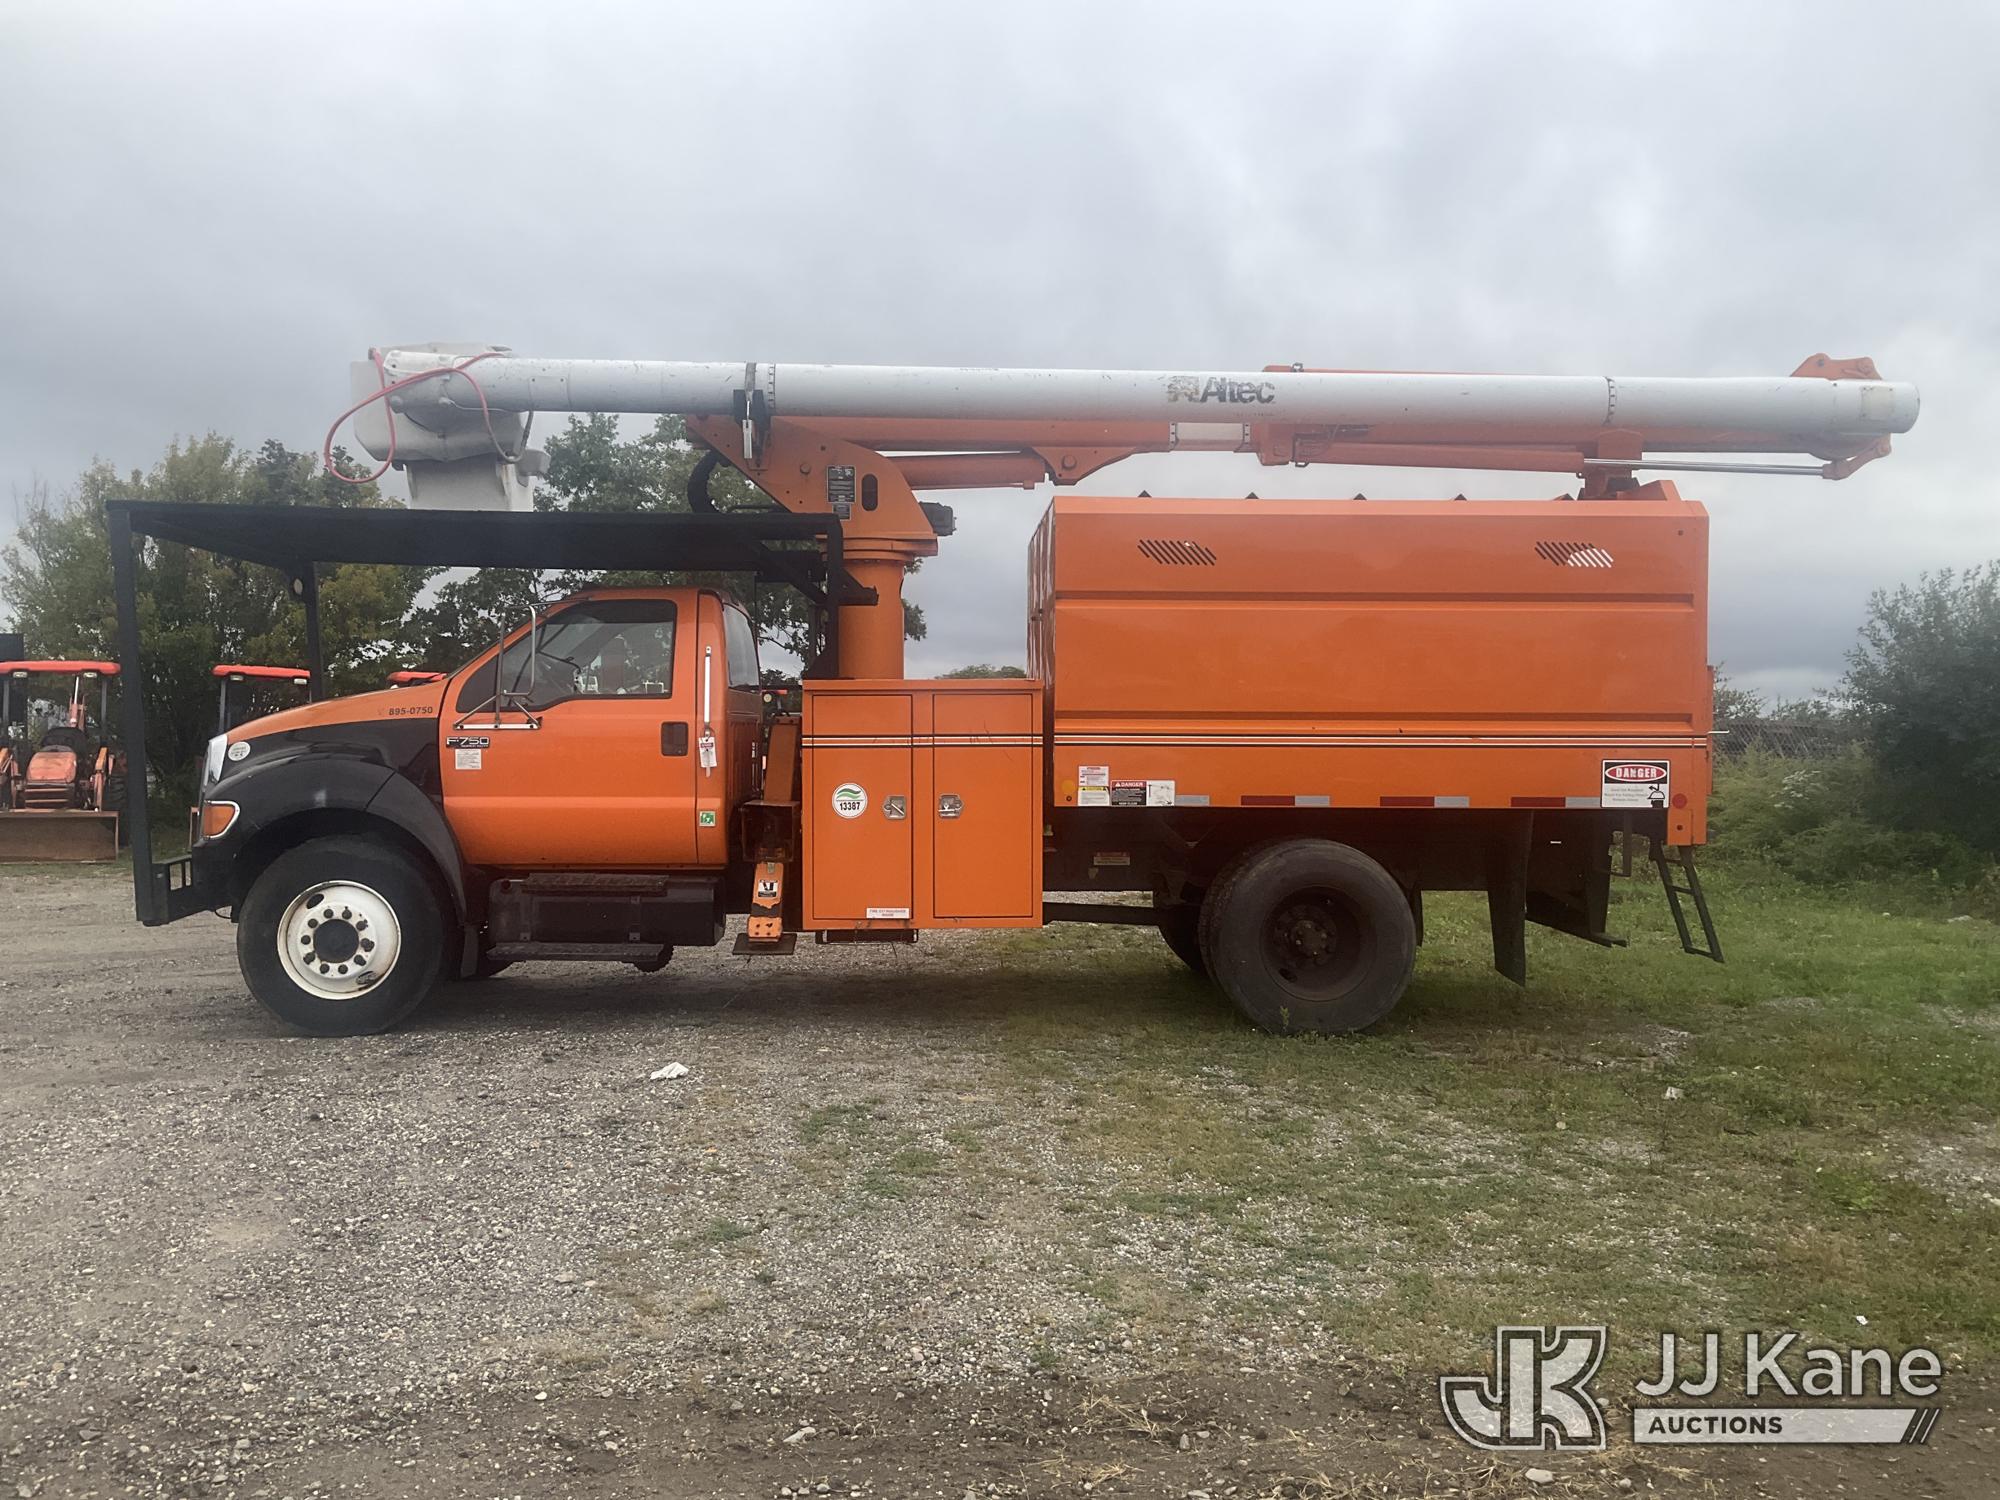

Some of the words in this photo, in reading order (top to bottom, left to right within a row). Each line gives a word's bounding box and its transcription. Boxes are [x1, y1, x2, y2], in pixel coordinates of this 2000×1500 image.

[1200, 377, 1275, 404] Altec
[388, 706, 433, 716] 895-0750
[1615, 767, 1657, 778] DANGER
[840, 802, 860, 811] 13387
